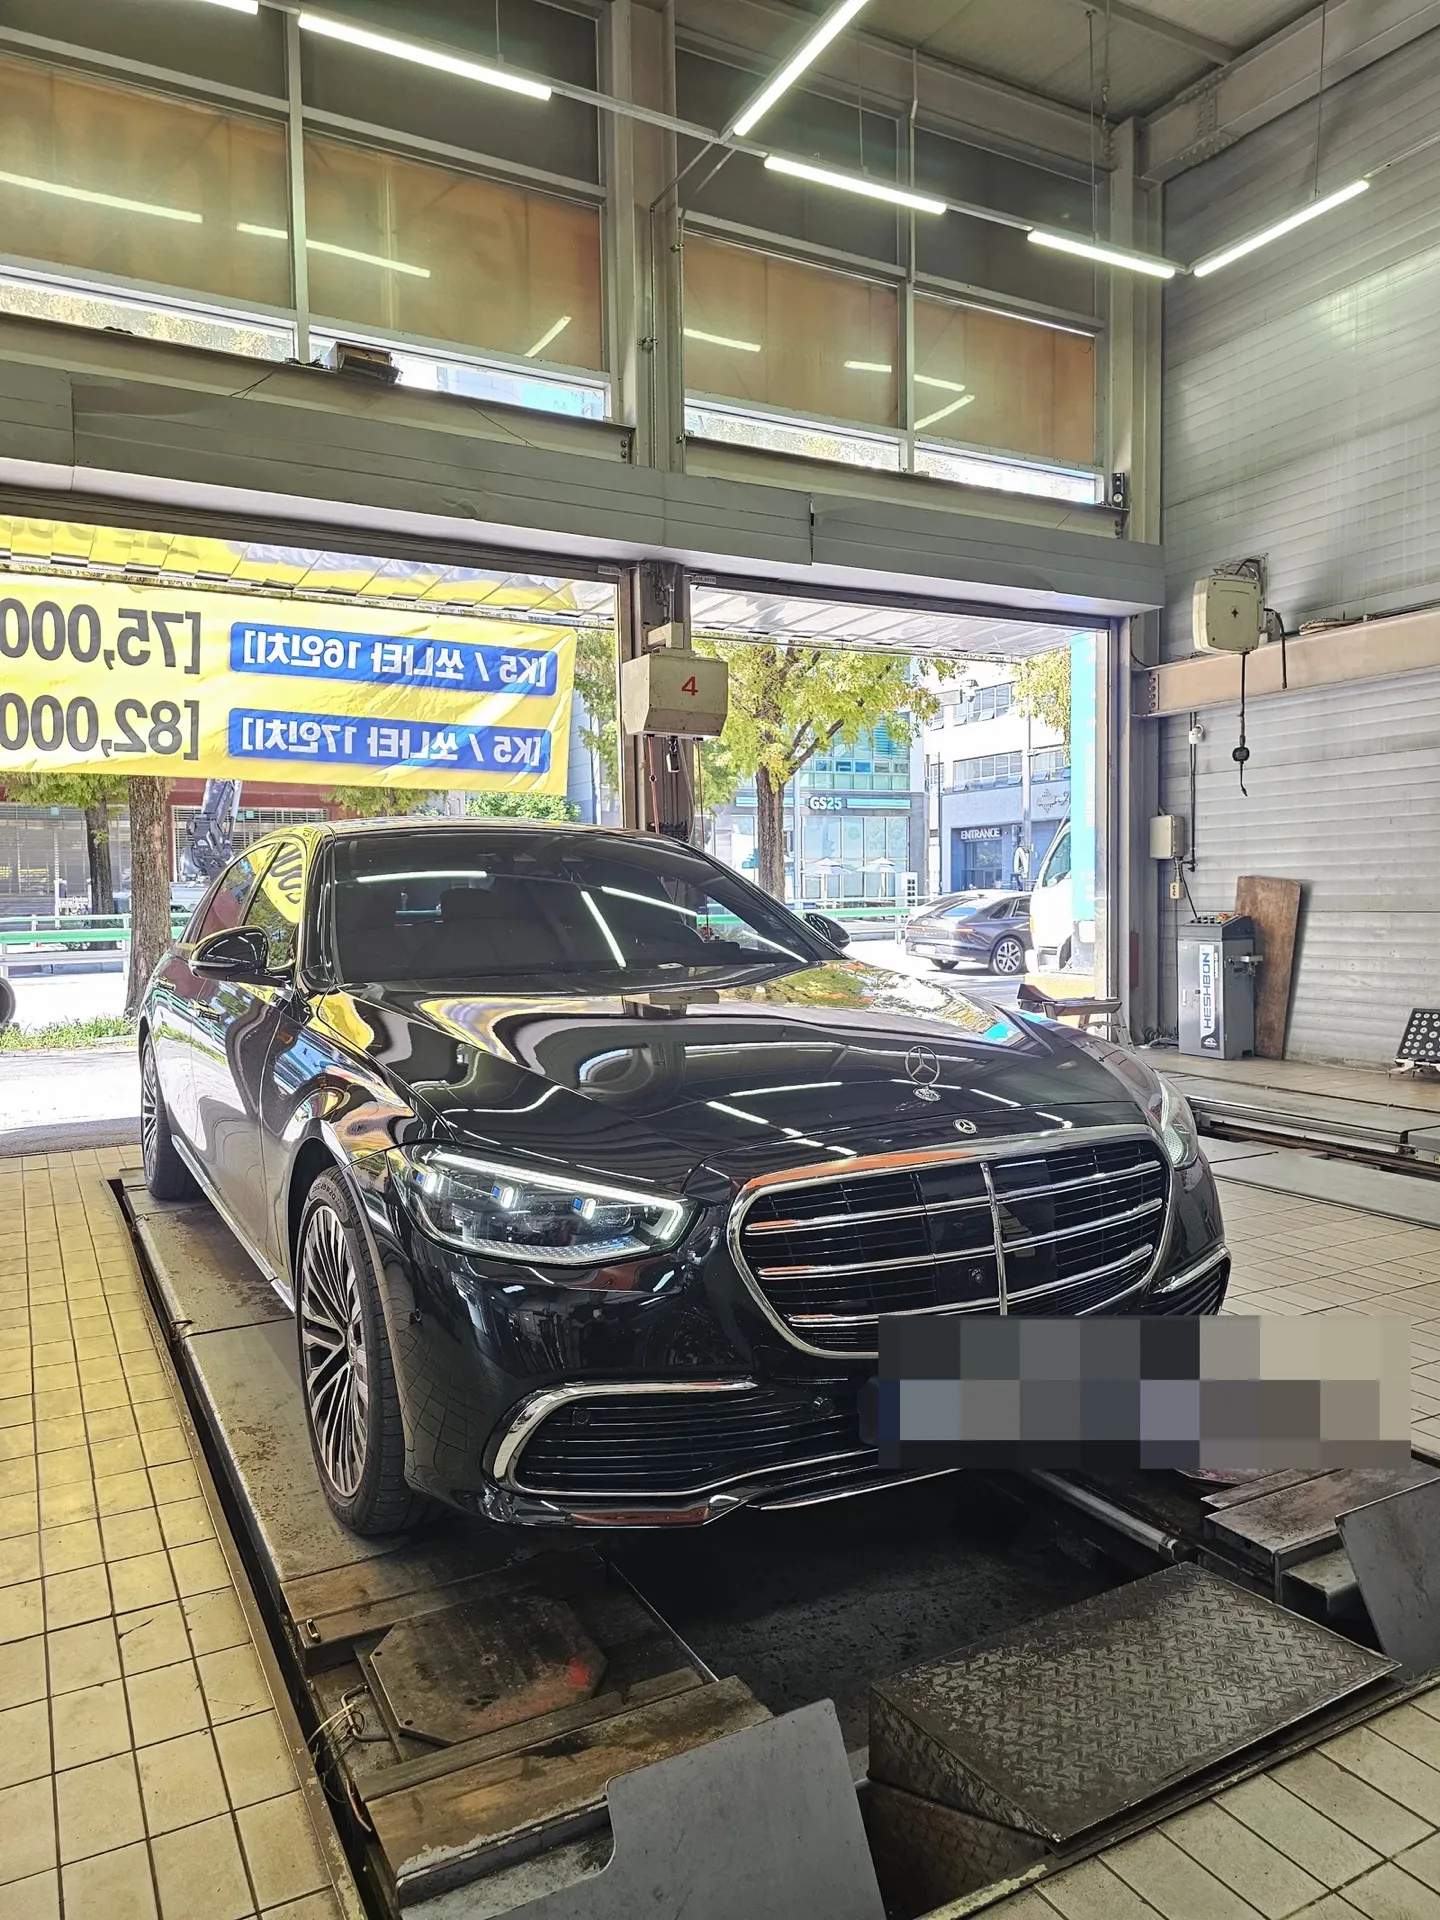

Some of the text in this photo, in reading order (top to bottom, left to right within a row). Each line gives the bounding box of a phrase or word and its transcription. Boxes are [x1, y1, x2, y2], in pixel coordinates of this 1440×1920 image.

[681, 676, 699, 696] 4
[810, 796, 842, 810] GS25
[960, 828, 1001, 840] ENTRANCE
[1202, 952, 1212, 1029] HESHBON
